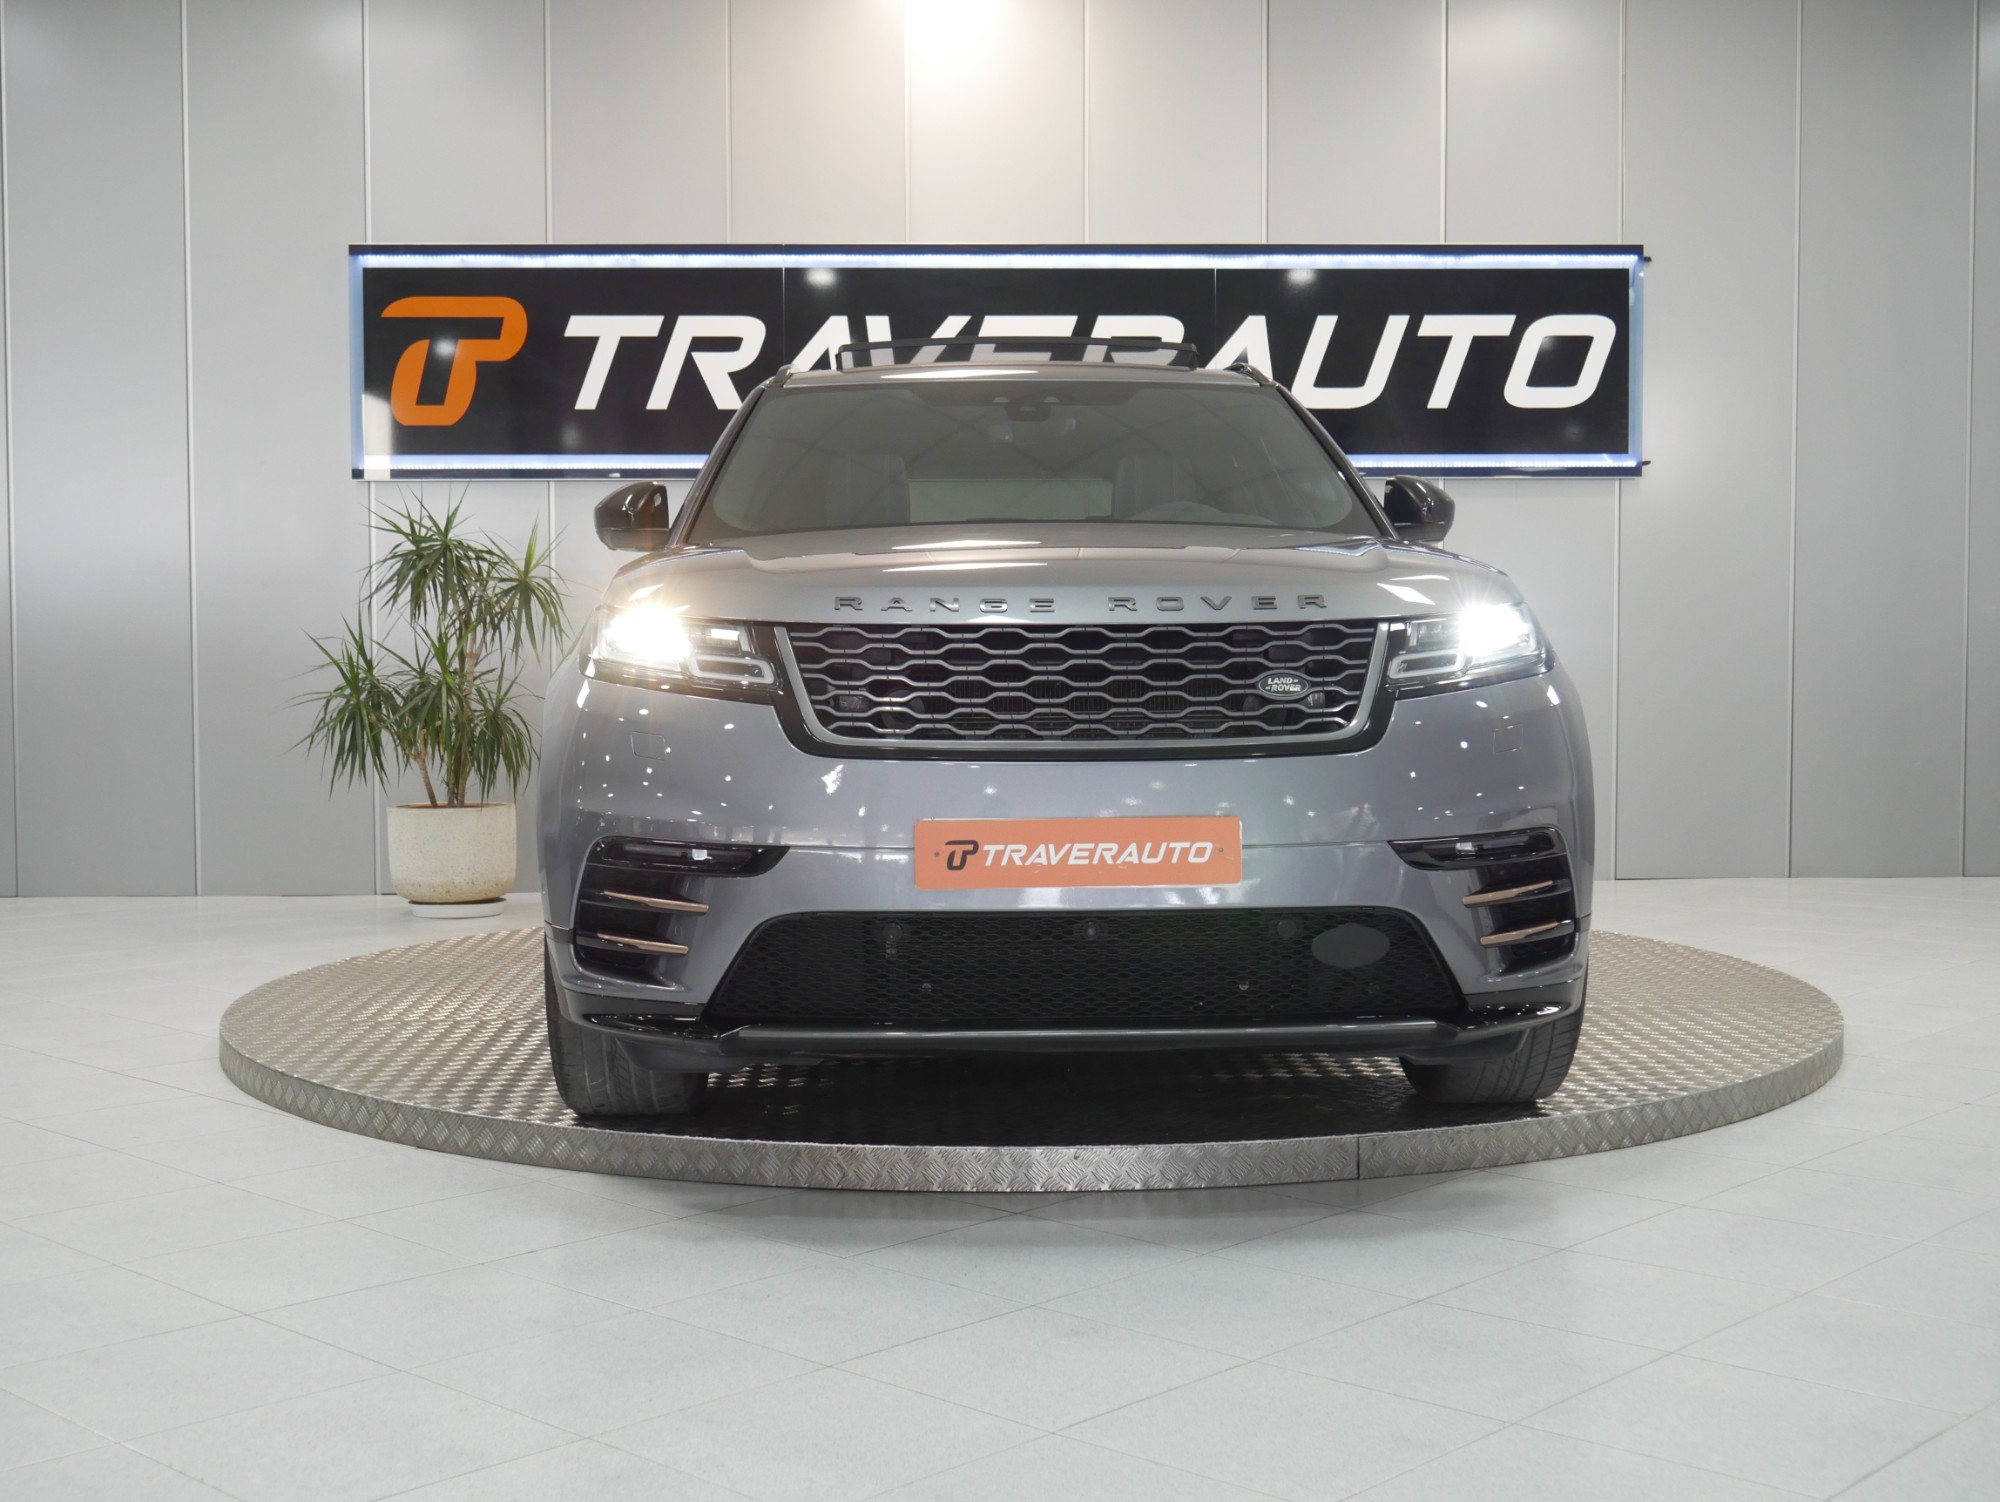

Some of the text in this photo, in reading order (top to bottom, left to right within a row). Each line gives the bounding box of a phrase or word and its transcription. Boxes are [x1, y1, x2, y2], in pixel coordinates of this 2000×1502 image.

[834, 594, 1327, 613] RANGE ROVER
[1267, 677, 1293, 685] LAND
[982, 841, 1213, 866] TRAVERAUTO
